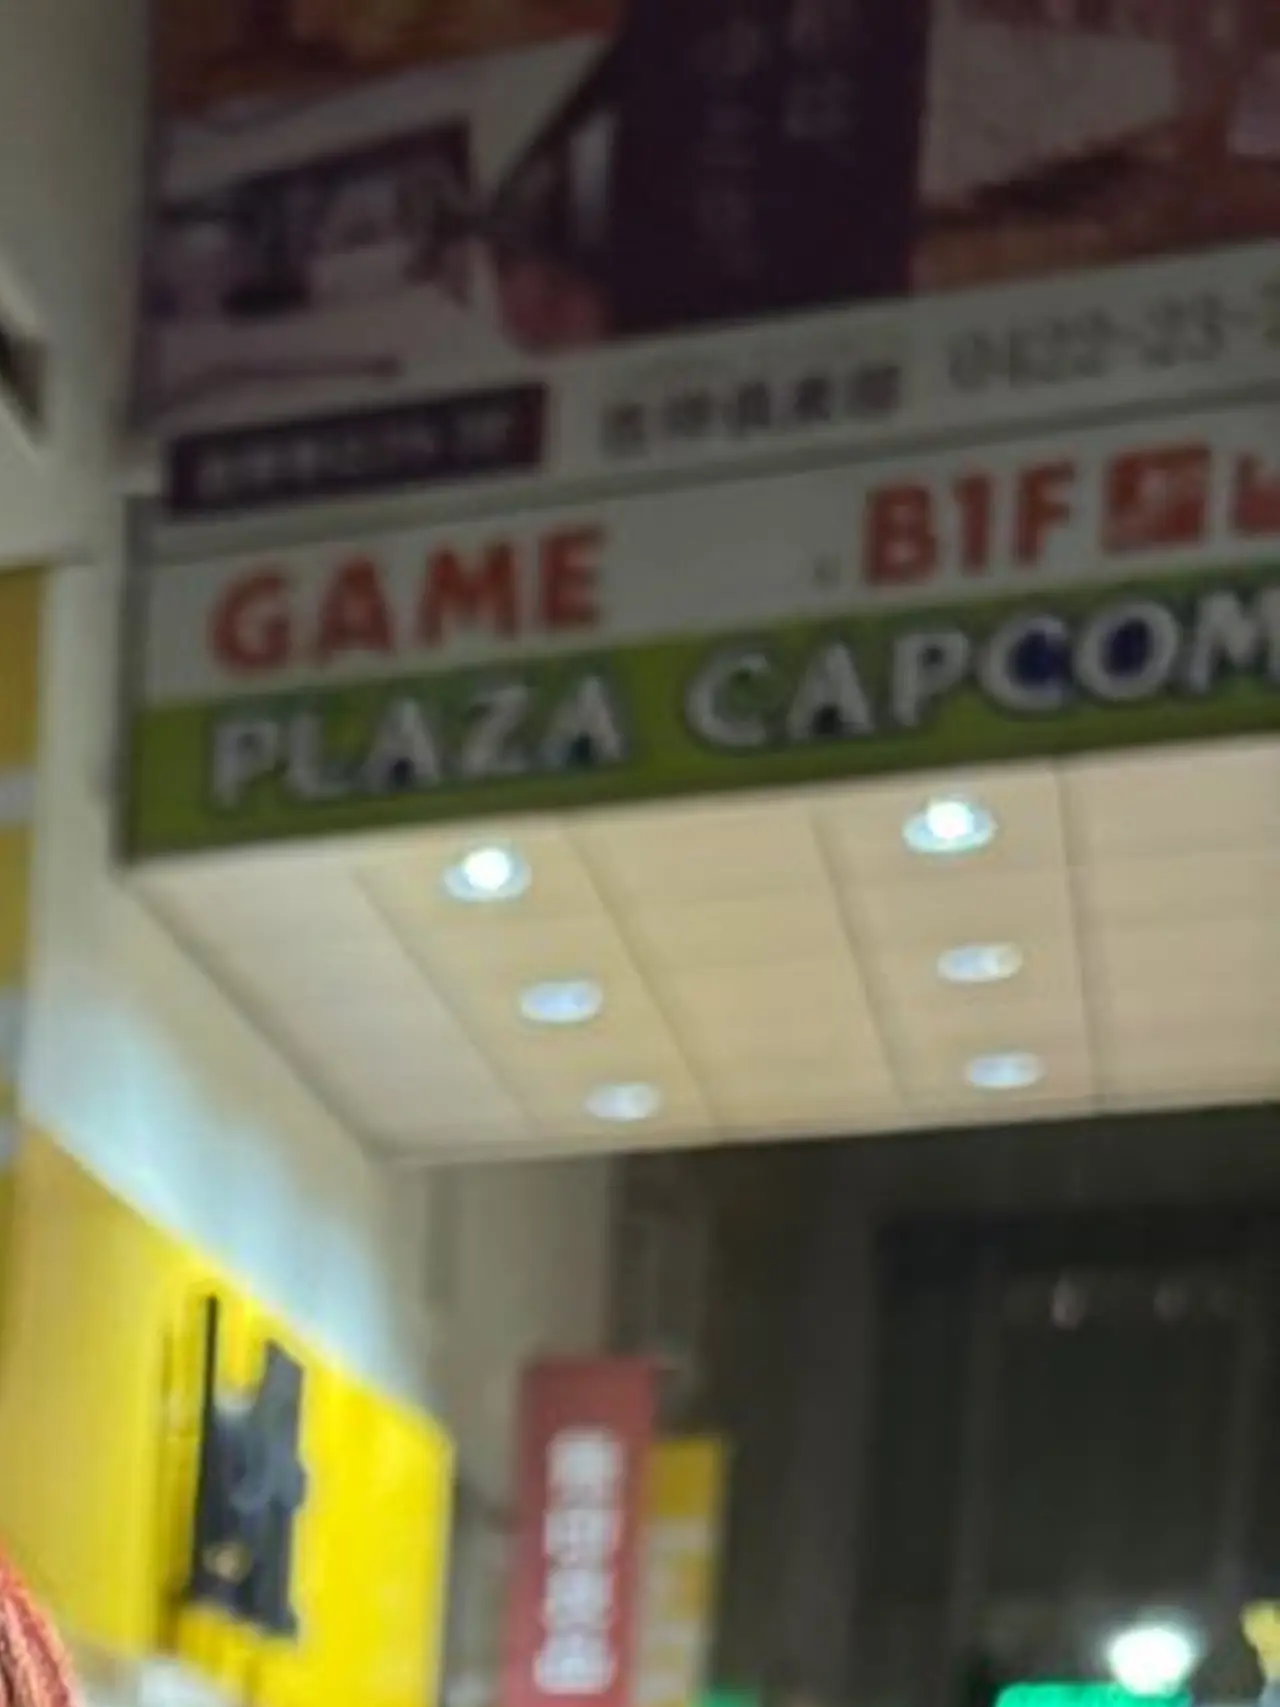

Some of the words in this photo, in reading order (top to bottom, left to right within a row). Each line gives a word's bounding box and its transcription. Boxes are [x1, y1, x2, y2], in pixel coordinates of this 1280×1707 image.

[210, 524, 606, 675] GAME
[862, 460, 1074, 584] B1F
[210, 678, 627, 806] PLAZA
[686, 588, 1280, 748] CAPCOM
